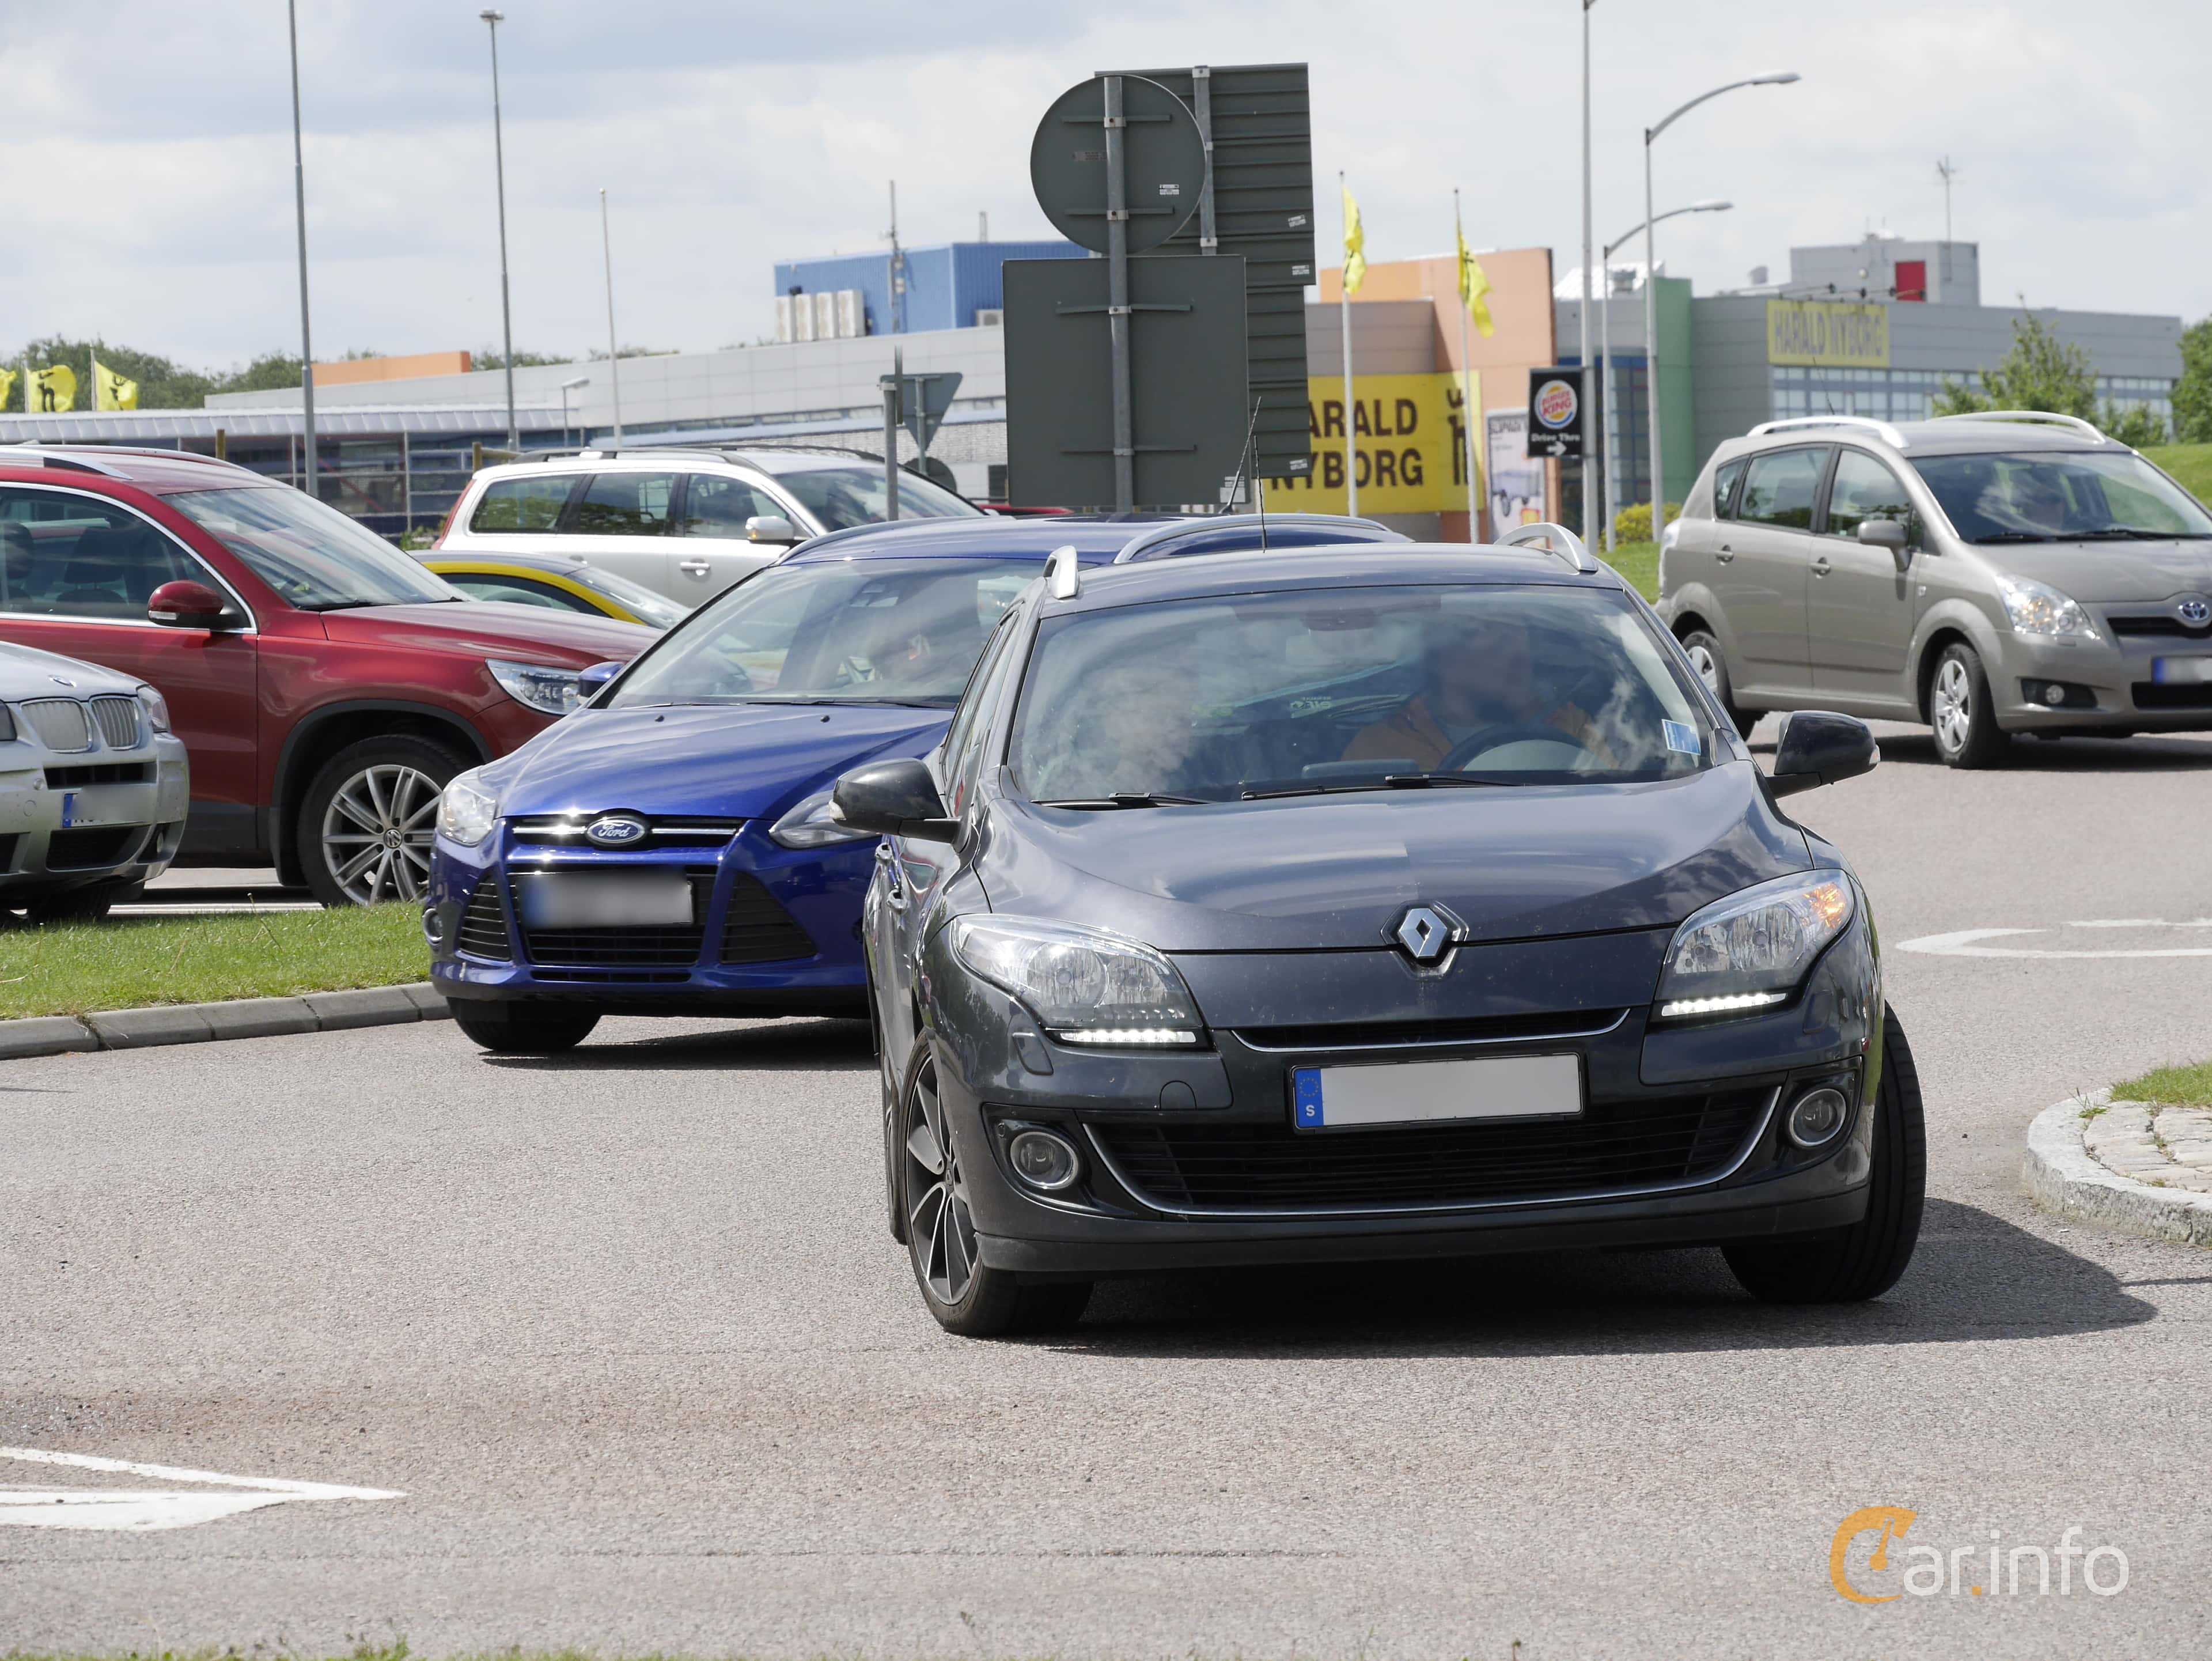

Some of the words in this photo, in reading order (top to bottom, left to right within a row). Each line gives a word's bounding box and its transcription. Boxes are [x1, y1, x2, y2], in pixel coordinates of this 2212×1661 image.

[1774, 311, 1825, 355] HARALD
[1543, 398, 1572, 417] KING
[1531, 433, 1556, 442] Drive
[1558, 433, 1581, 441] Thru
[598, 823, 631, 837] Ford
[1306, 1104, 1315, 1117] S
